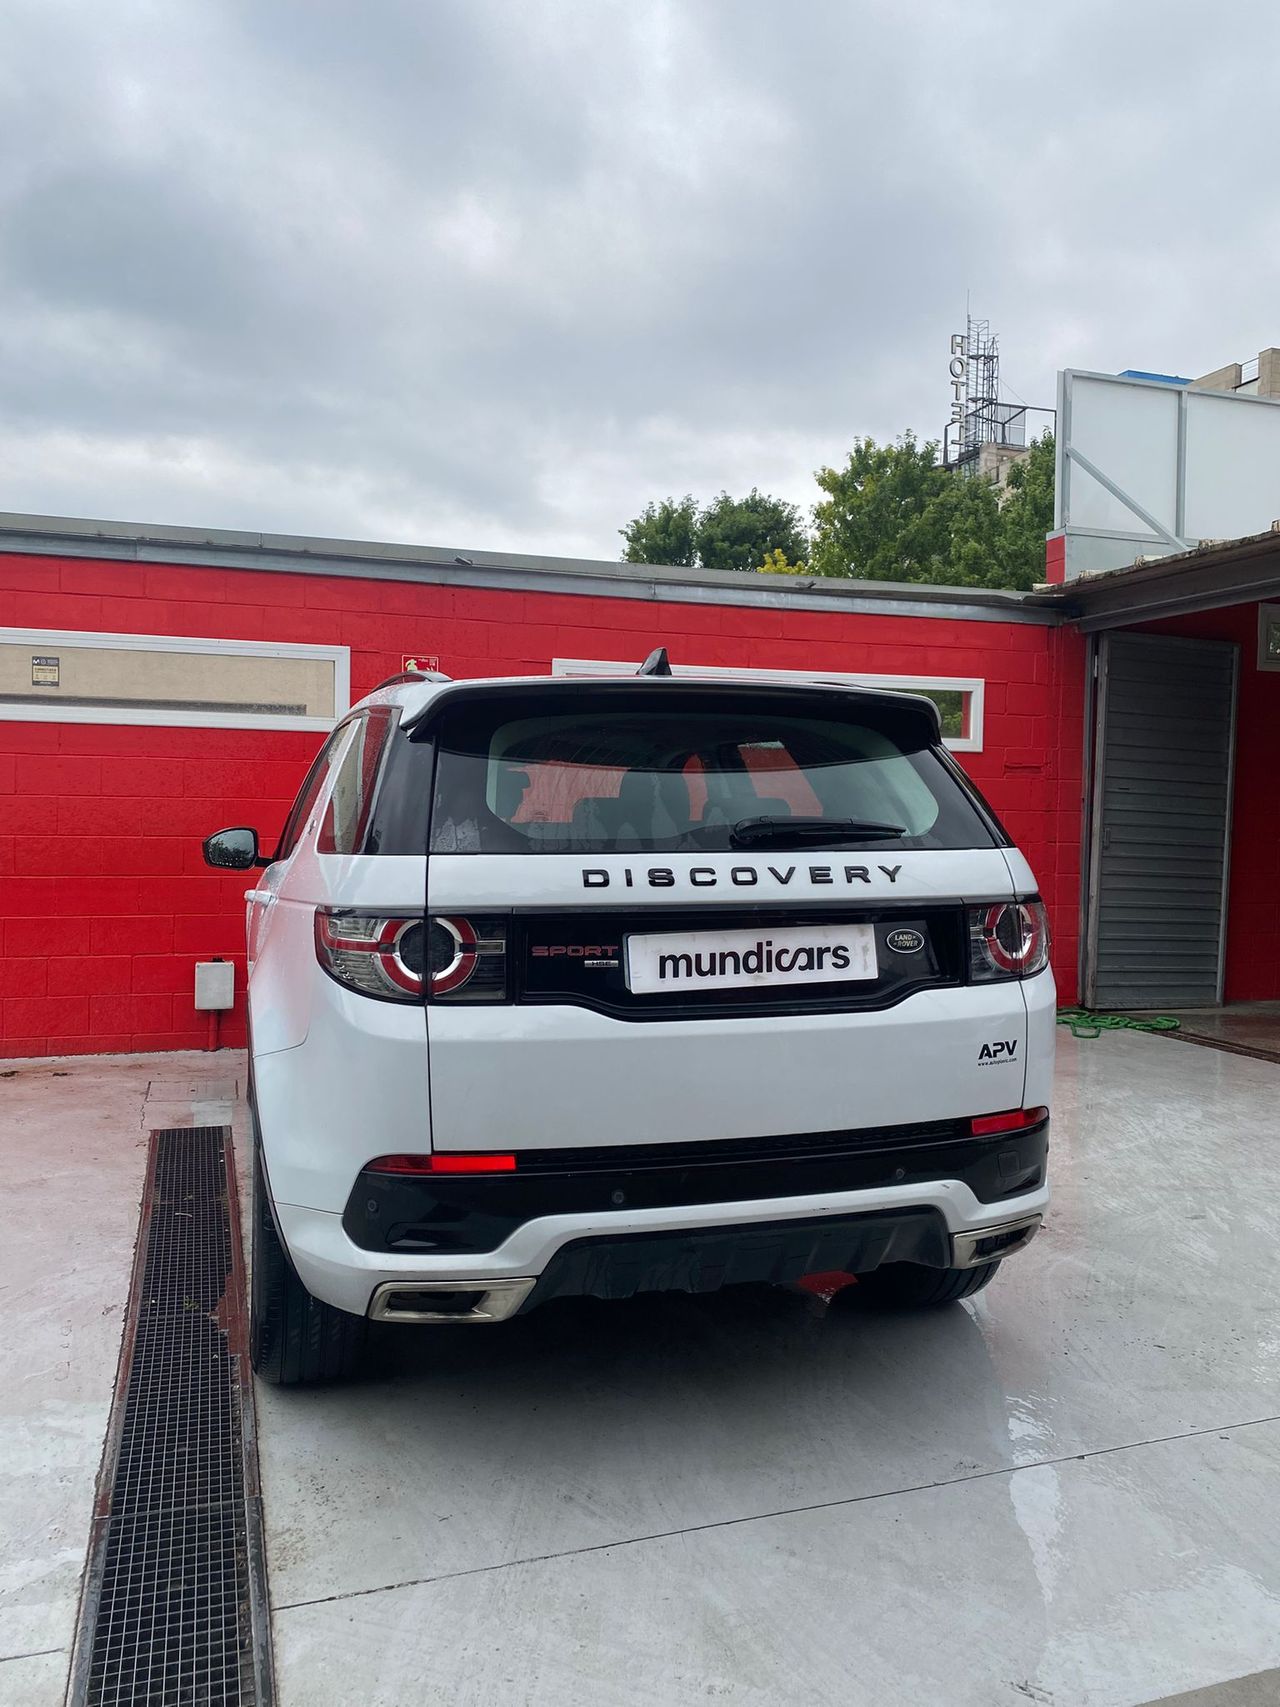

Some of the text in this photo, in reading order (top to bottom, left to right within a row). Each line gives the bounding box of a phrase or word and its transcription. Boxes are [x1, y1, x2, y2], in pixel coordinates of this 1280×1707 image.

[582, 865, 902, 888] DISCOVERY
[894, 933, 913, 941] LAND
[531, 945, 619, 957] SPORT
[659, 940, 851, 979] mundicars
[978, 1039, 1018, 1060] APV
